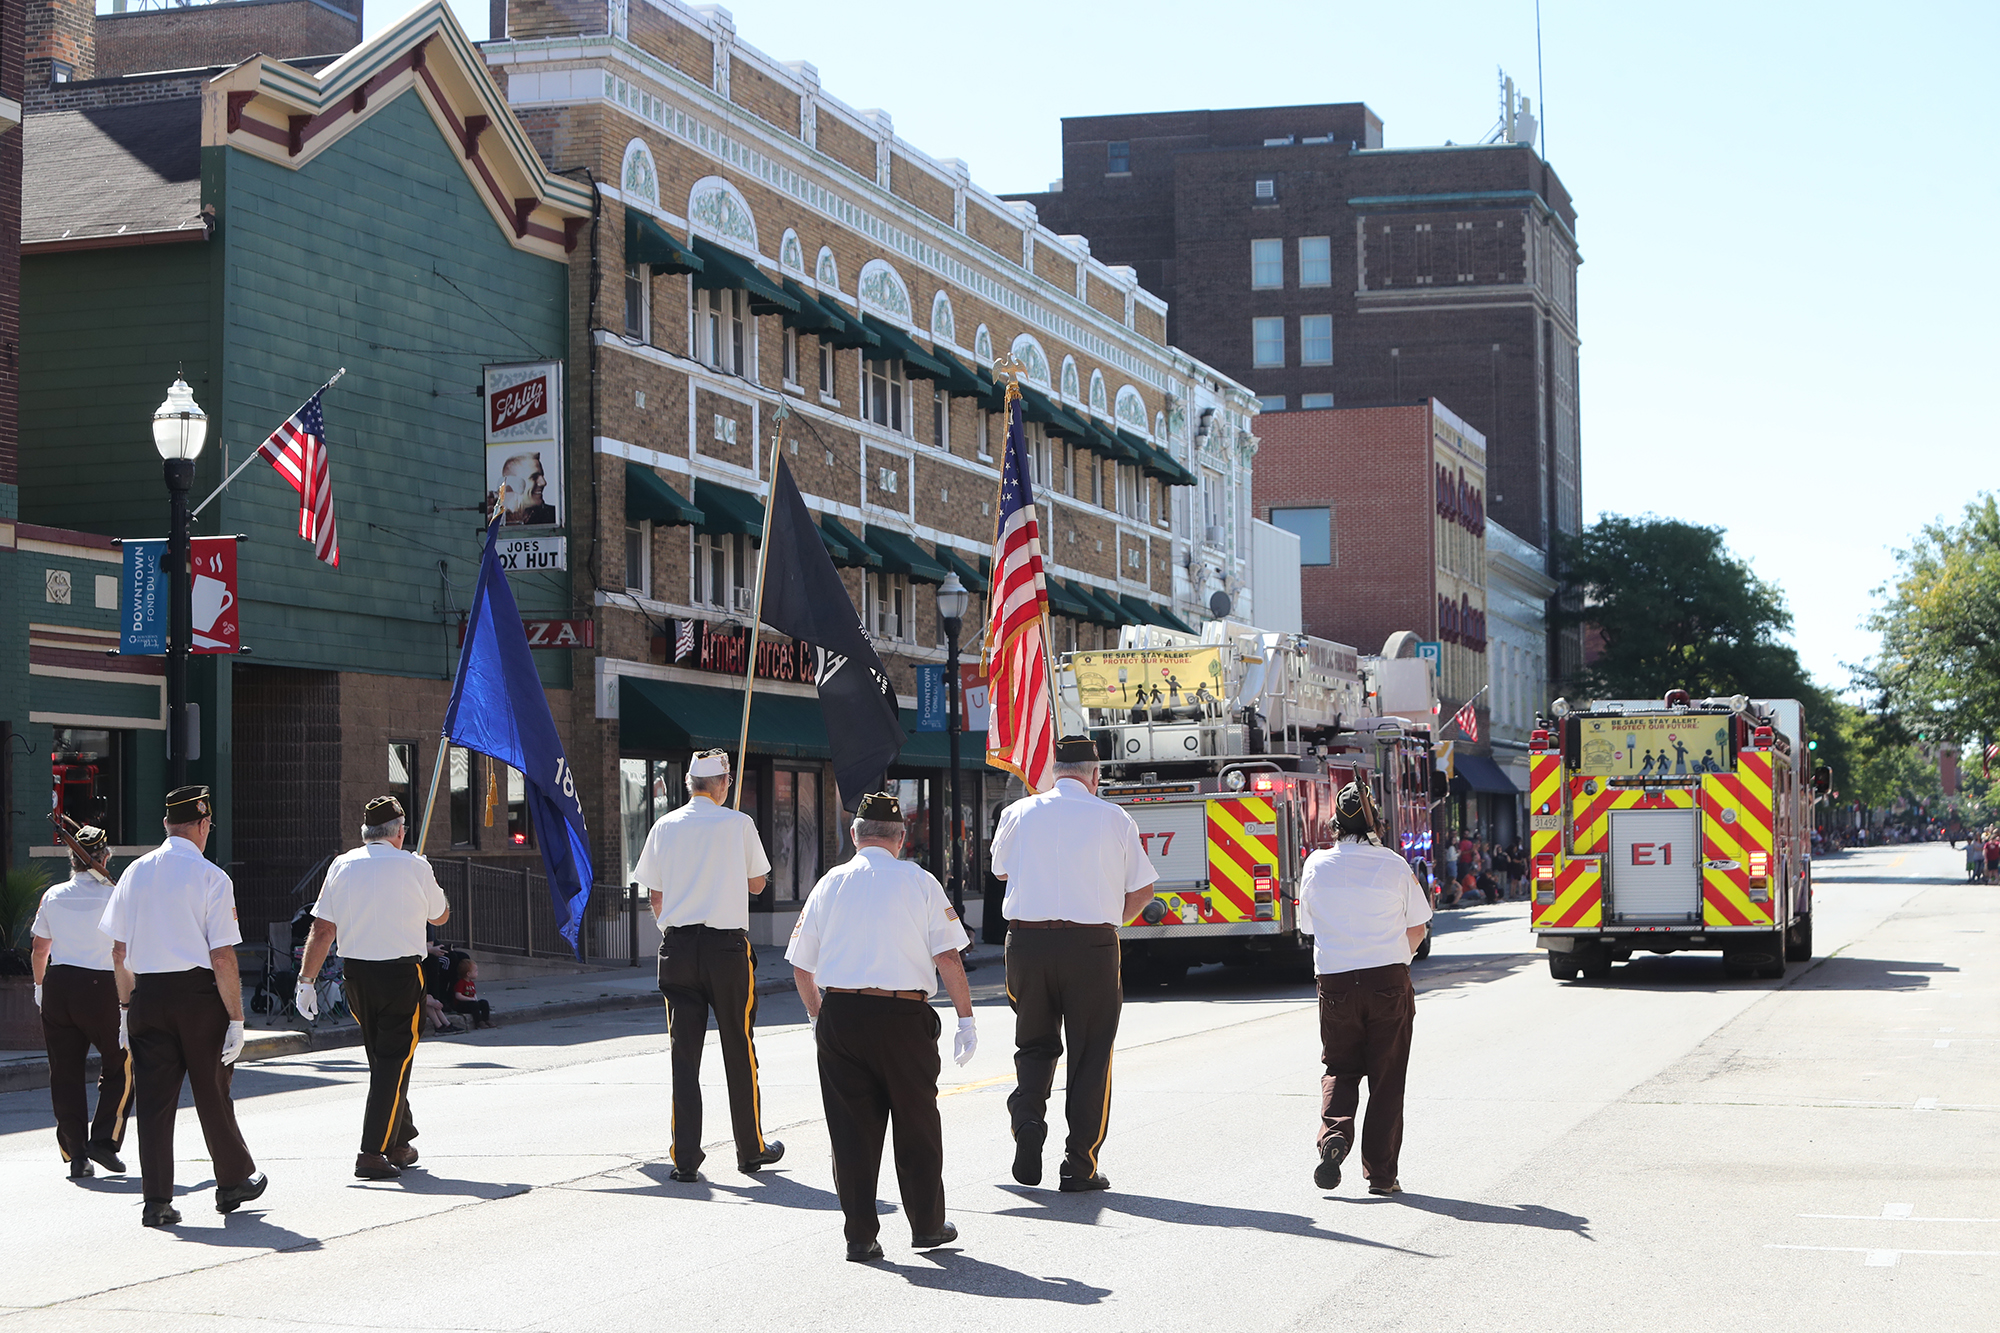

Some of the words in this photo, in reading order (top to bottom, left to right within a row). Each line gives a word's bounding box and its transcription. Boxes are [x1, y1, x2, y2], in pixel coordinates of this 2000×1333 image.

[496, 382, 543, 426] Schlitz
[507, 541, 539, 553] JOE'S
[147, 555, 155, 574] LAC
[498, 554, 518, 569] OX
[526, 552, 558, 568] HUT
[133, 546, 144, 632] DOWNTOWN
[146, 577, 155, 591] DU
[146, 593, 155, 622] FOND
[701, 619, 746, 674] Armed
[757, 640, 794, 681] orces
[924, 667, 932, 718] DOWNTOWN
[1535, 818, 1558, 827] 31492
[1139, 832, 1176, 856] T7
[1631, 842, 1672, 866] E1
